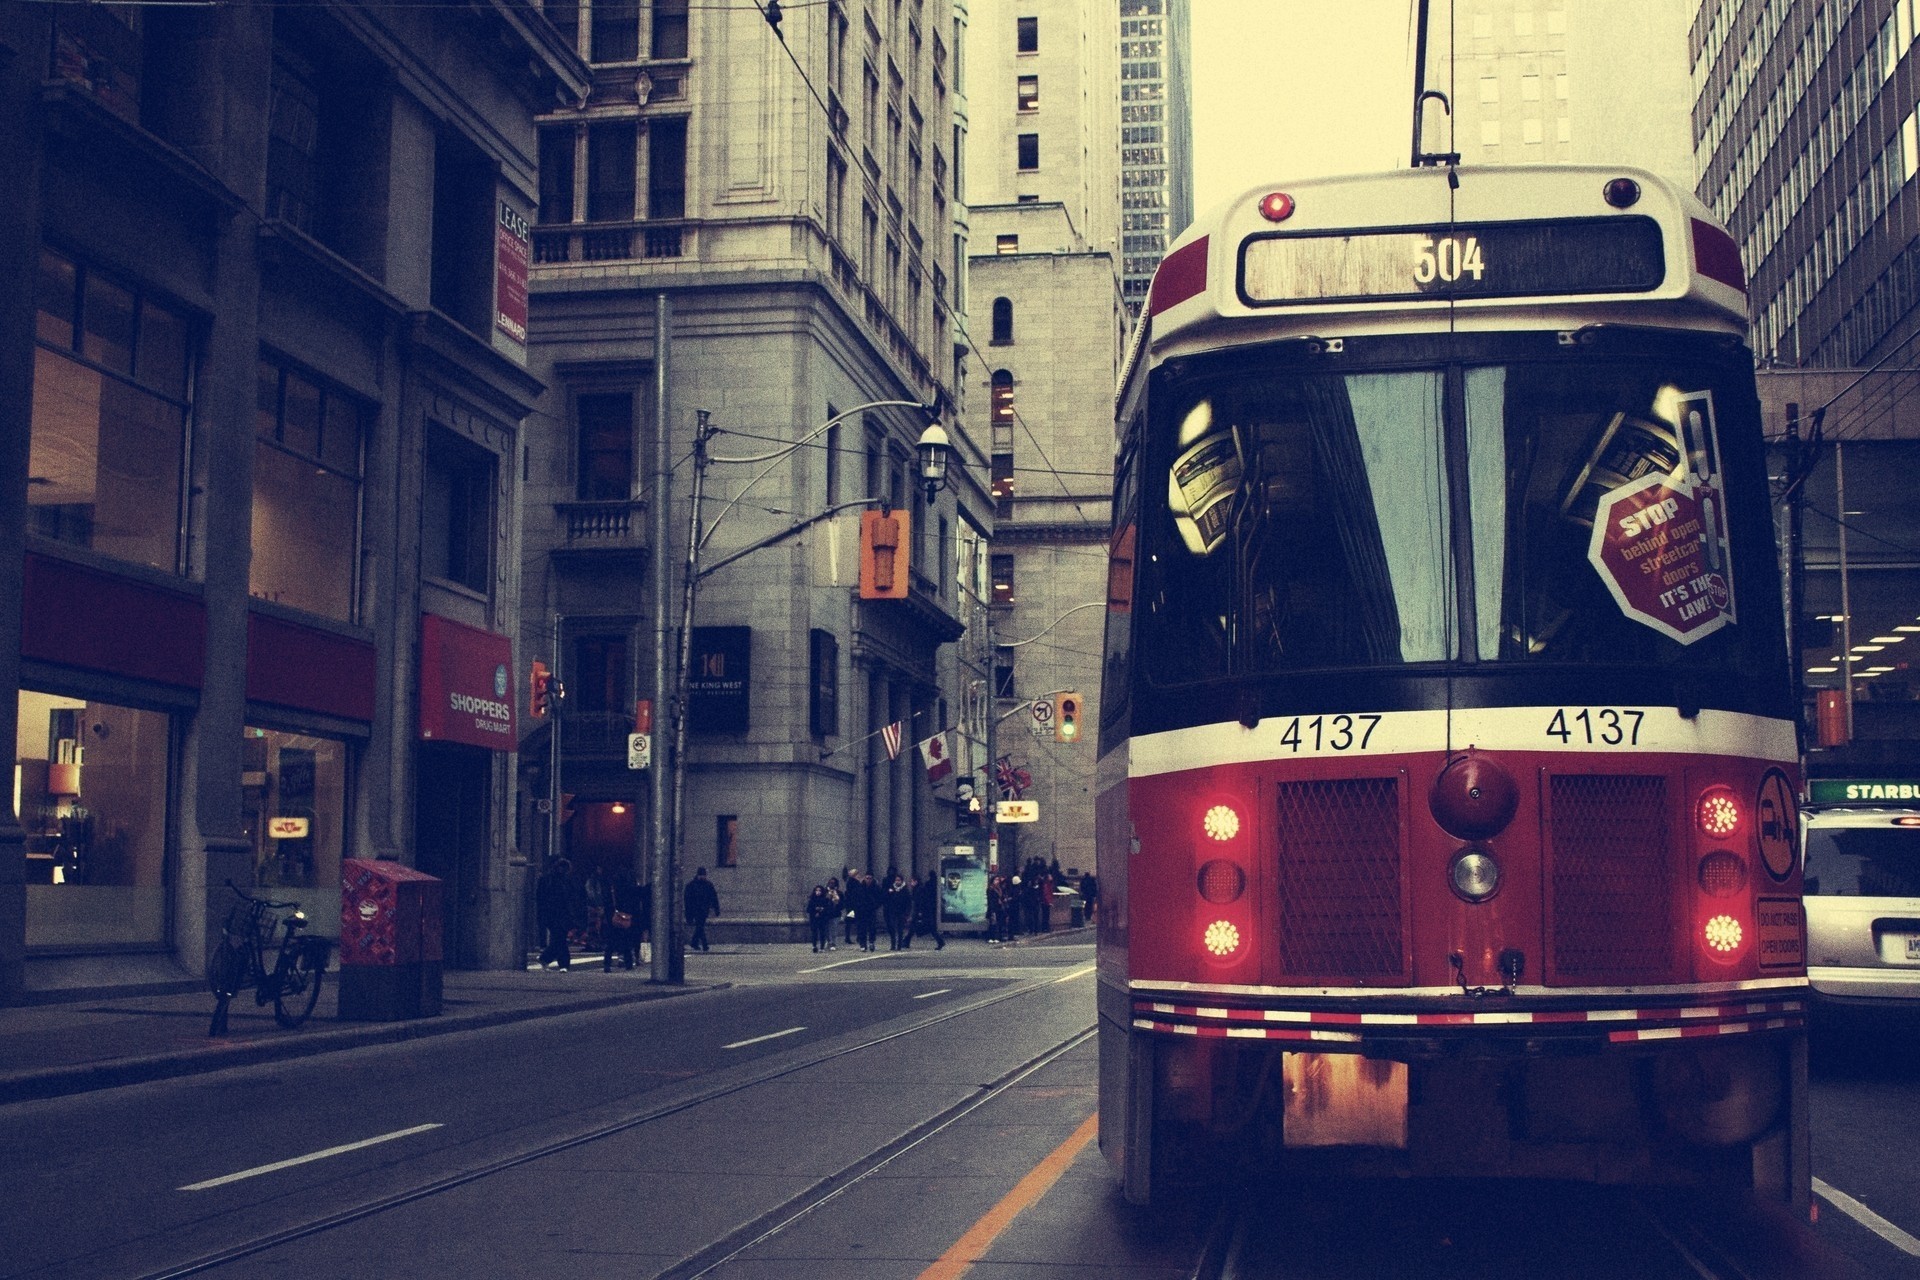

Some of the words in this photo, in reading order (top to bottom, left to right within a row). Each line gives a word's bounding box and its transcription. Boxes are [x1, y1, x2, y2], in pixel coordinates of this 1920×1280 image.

[500, 201, 528, 243] LEASE
[1414, 237, 1484, 283] 504
[497, 310, 526, 340] LENNARD
[1619, 497, 1679, 538] STOP
[1621, 531, 1669, 562] behind
[1670, 518, 1700, 541] open
[1640, 539, 1700, 575] streetcar
[1659, 584, 1689, 609] IT'S
[1688, 573, 1713, 595] THE
[1662, 561, 1699, 586] doors
[1678, 595, 1712, 622] LAW!
[1709, 585, 1727, 600] STOP
[722, 681, 742, 689] WEST
[450, 692, 510, 720] SHOPPERS
[475, 718, 493, 732] DRUG
[493, 722, 511, 735] MART
[1281, 714, 1382, 752] 4137
[1545, 708, 1645, 746] 4137
